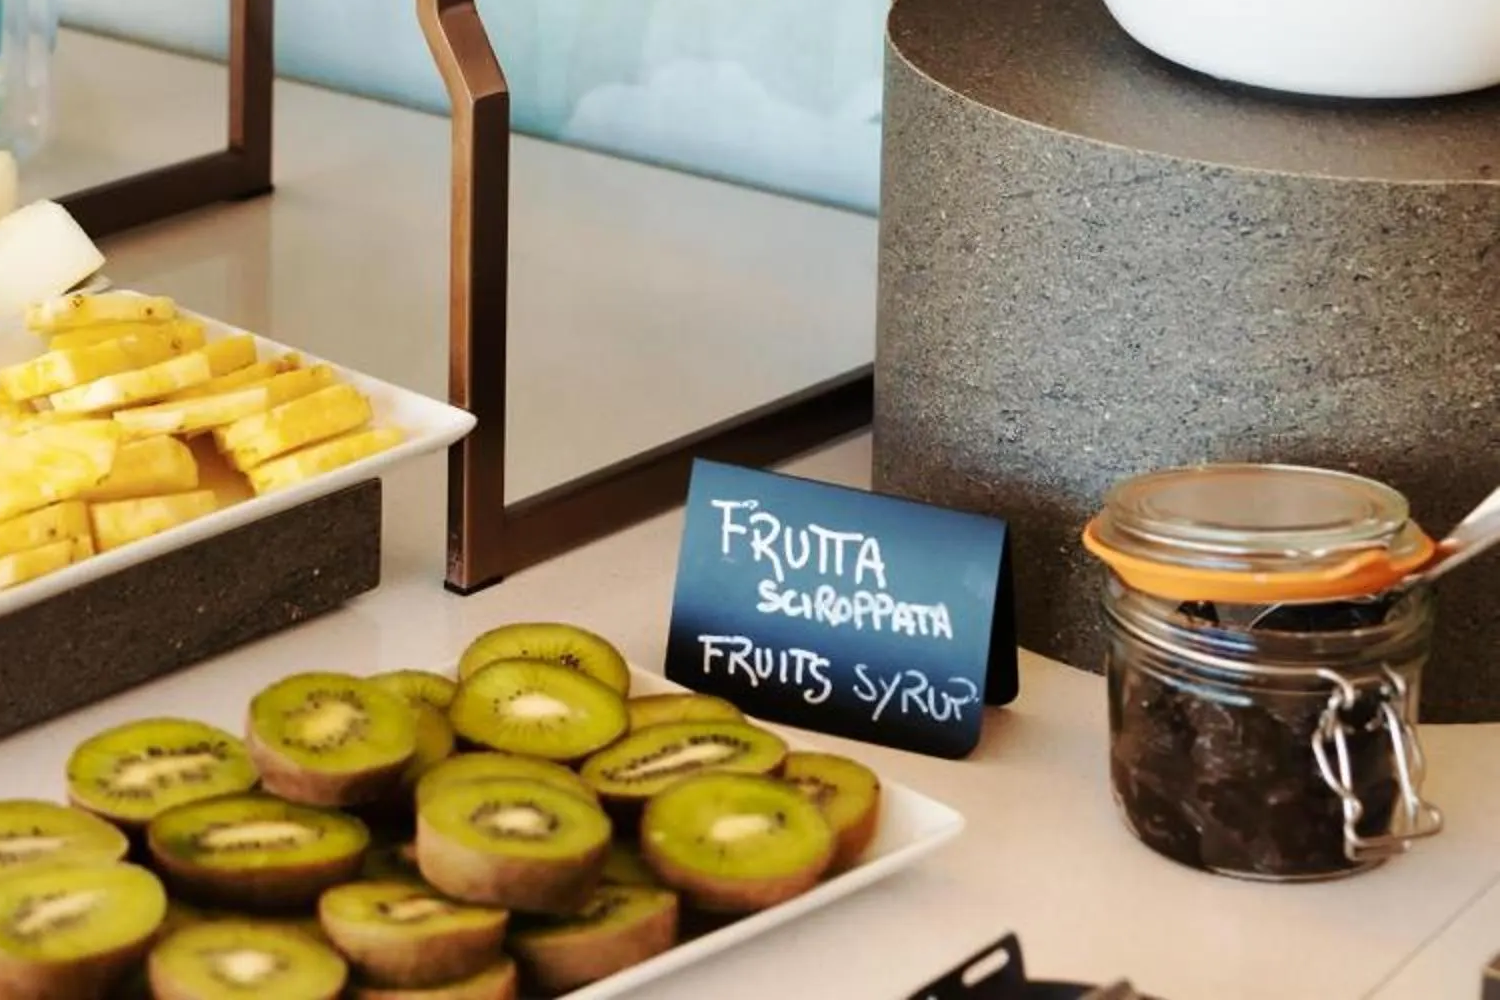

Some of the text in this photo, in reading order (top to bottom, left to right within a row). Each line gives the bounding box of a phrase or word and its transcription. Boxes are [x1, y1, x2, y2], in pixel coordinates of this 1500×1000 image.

[711, 498, 887, 589] FRUTTA
[756, 578, 954, 640] SCIROPPATA
[697, 633, 980, 722] FRUITS SYRUP
